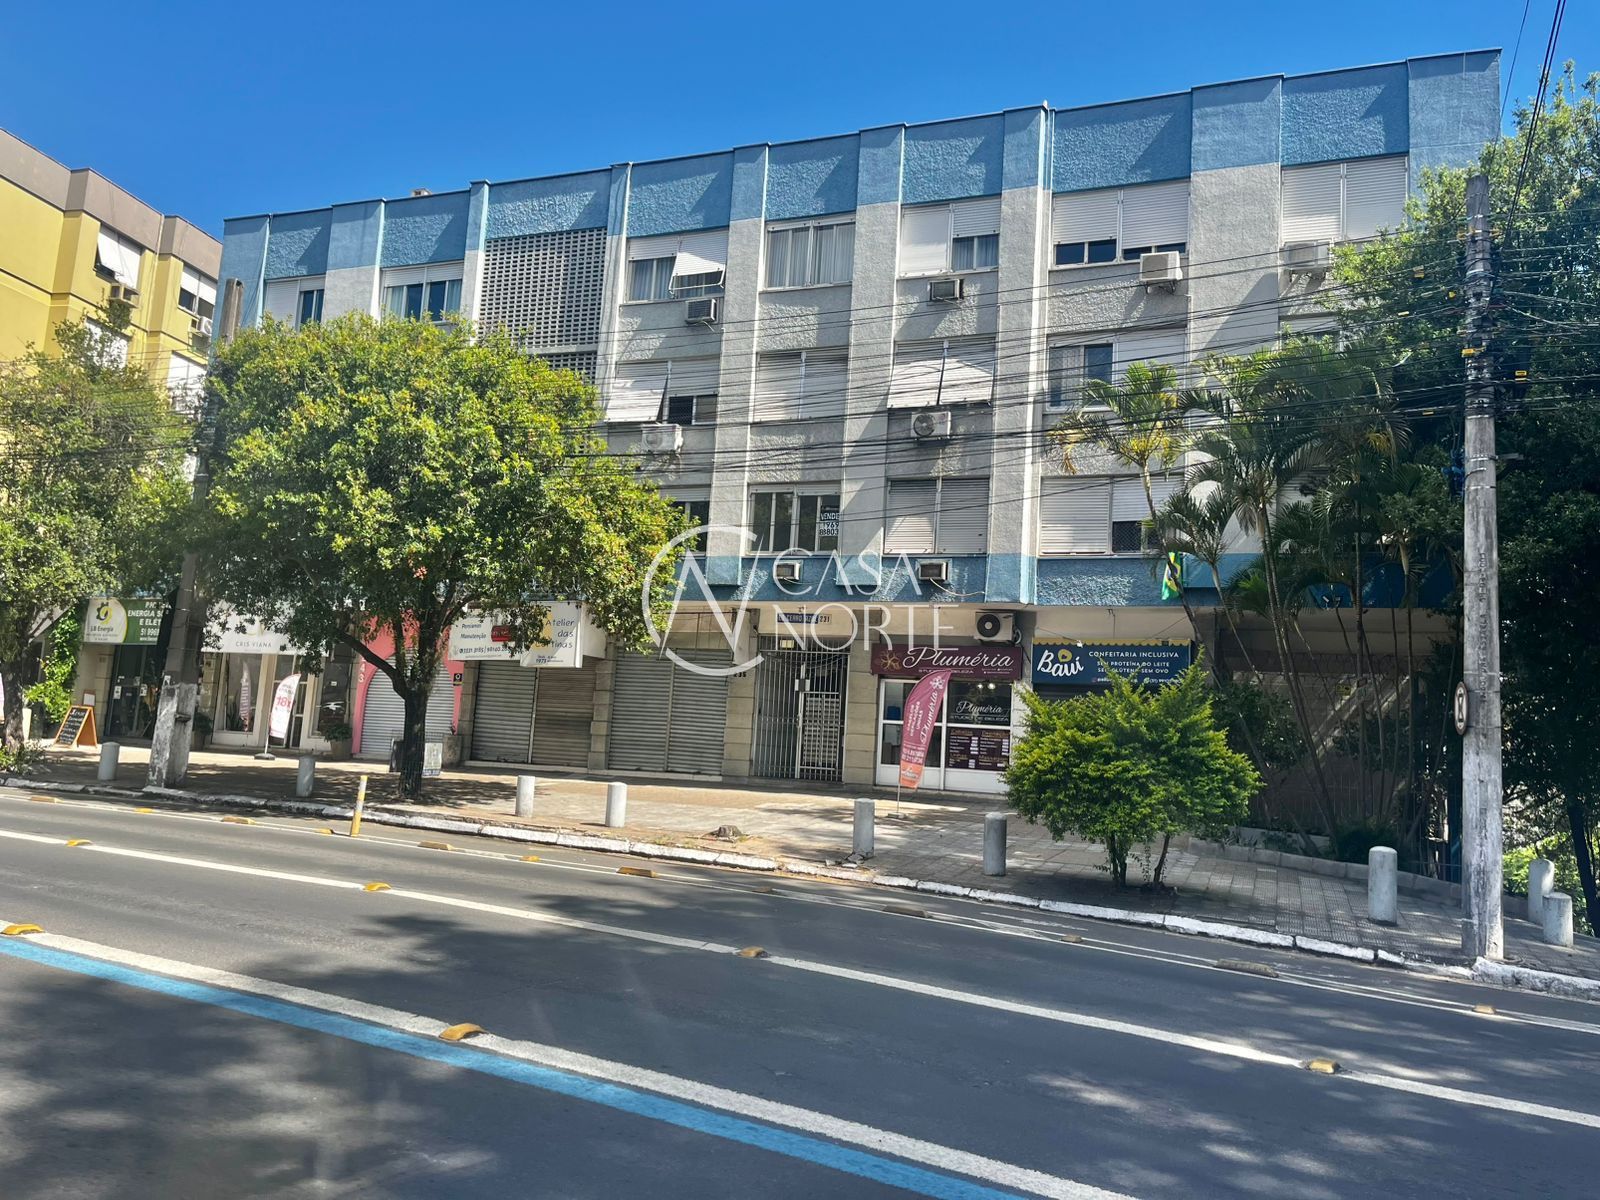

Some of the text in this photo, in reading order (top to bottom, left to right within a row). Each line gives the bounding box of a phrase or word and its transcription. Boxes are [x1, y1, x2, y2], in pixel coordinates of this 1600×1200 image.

[127, 609, 155, 618] ENERGIA
[545, 618, 575, 627] Atelier
[557, 630, 574, 638] das
[252, 641, 272, 649] VIANA
[902, 646, 1014, 669] Pluméria
[1139, 651, 1179, 659] INCLUSIVA
